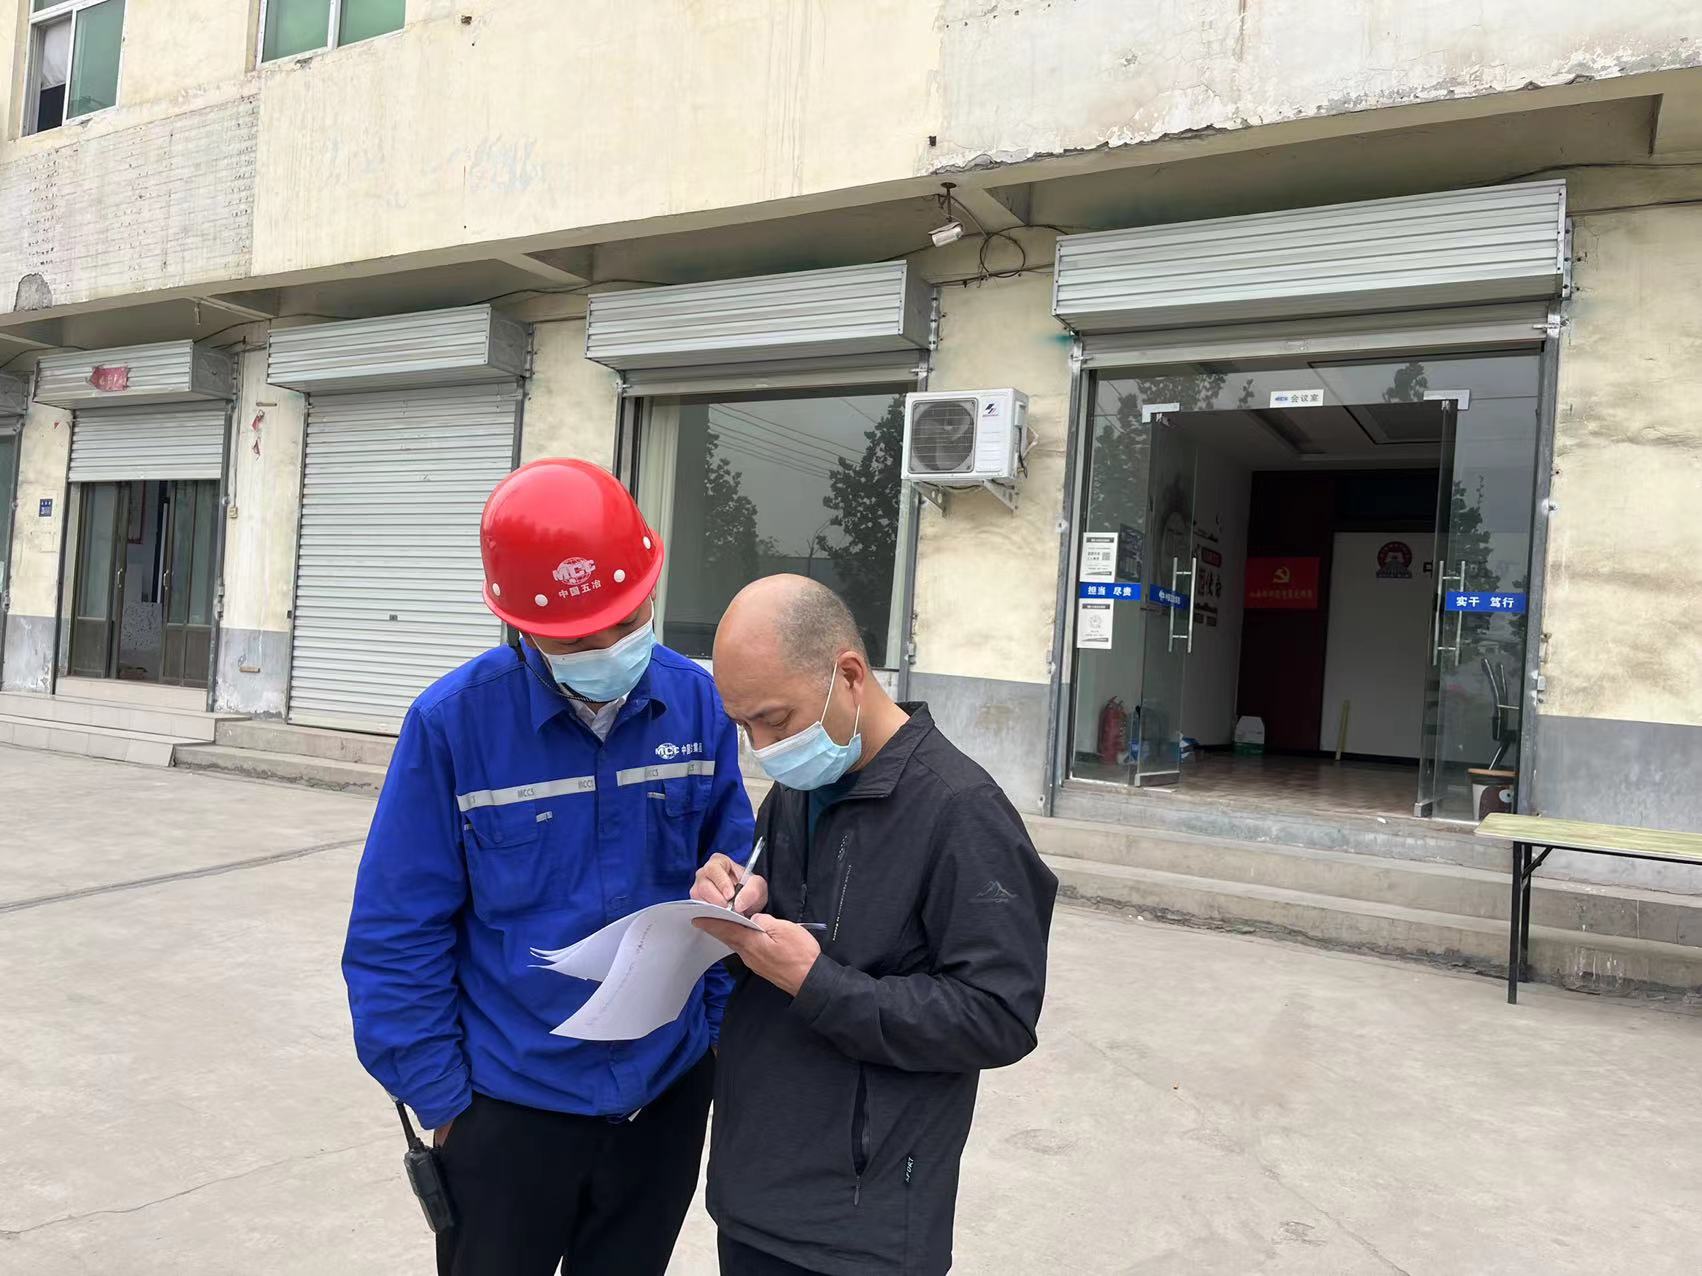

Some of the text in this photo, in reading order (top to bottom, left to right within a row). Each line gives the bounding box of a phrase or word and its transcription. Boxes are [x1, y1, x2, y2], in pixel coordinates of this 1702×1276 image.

[1291, 394, 1319, 403] 会议室
[553, 559, 596, 582] MCC
[559, 580, 601, 598] 中国五冶
[1087, 586, 1106, 596] 担当
[1456, 596, 1514, 608] 实干 笃行
